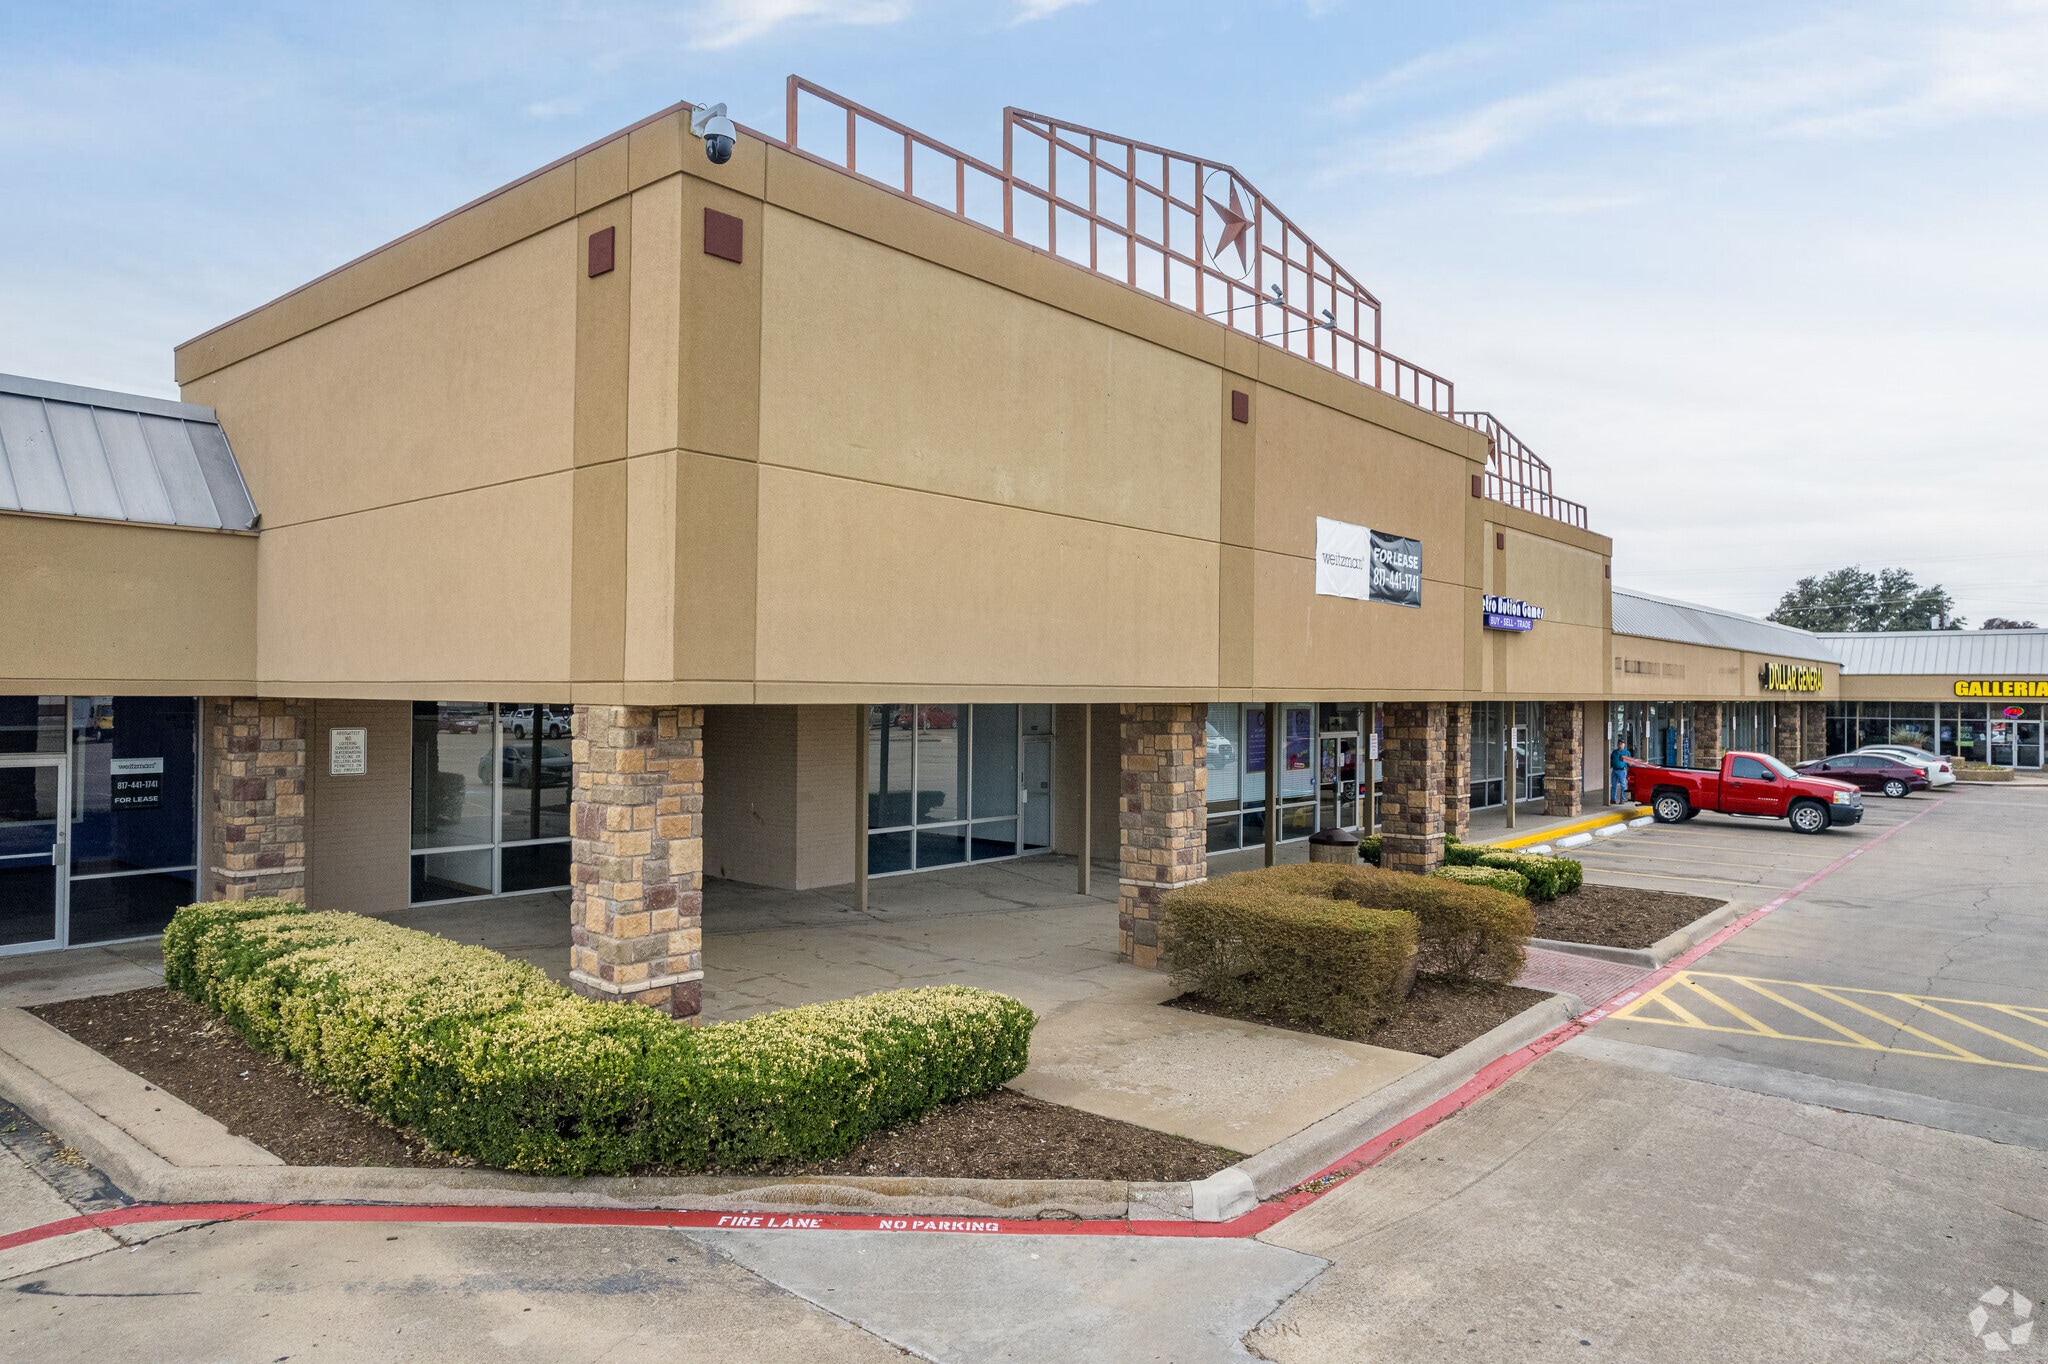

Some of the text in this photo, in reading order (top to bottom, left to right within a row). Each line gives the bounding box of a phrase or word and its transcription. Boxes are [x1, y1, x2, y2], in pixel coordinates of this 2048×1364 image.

[1373, 547, 1419, 569] FOR LEASE
[1373, 567, 1419, 592] 817-441-1741
[1497, 597, 1521, 617] Button
[1522, 601, 1544, 619] Games
[1490, 616, 1531, 629] BUY SELL TRADE
[1768, 662, 1825, 691] DOLLAR GENERAL
[1954, 680, 2048, 697] GALLERIA
[117, 780, 158, 790] 817-441-1741
[132, 795, 159, 803] LEASE
[717, 1215, 999, 1232] FIRE LANE NO PARKING
